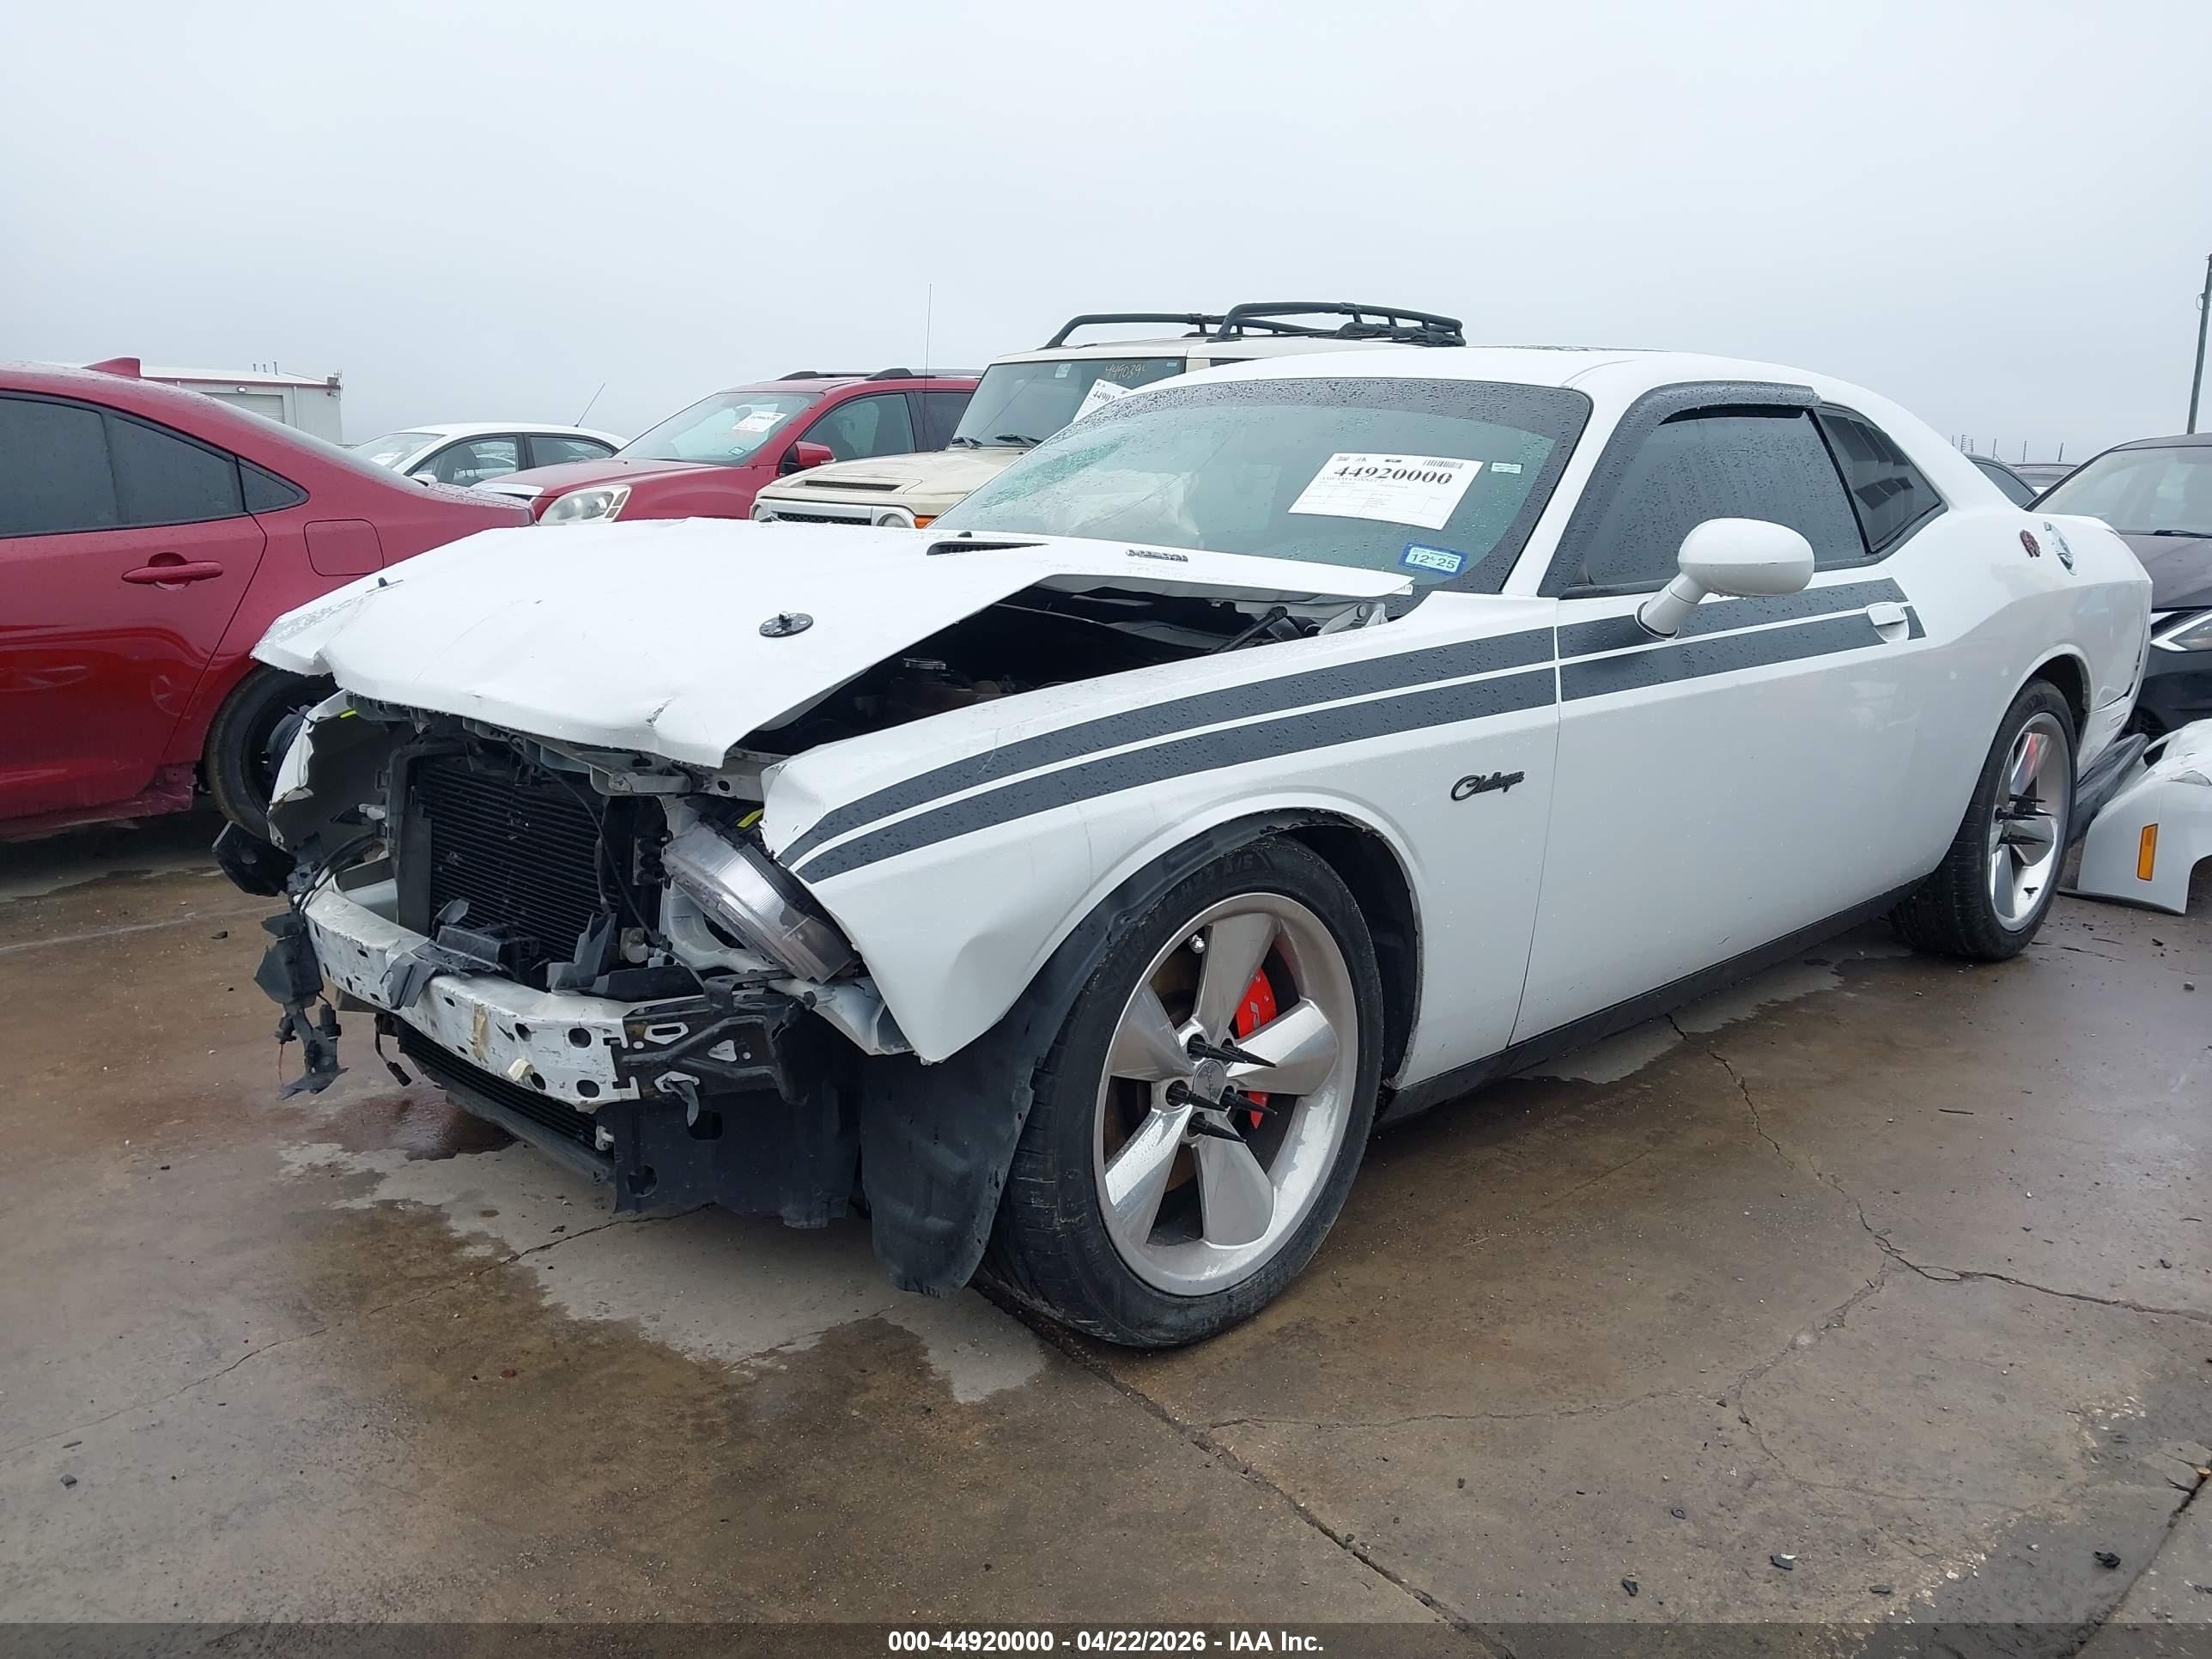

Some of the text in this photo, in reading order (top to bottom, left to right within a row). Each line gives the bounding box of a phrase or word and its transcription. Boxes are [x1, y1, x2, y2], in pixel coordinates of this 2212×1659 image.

[1334, 466, 1453, 485] 44920000
[1411, 554, 1430, 563] 12
[1436, 557, 1457, 569] 25
